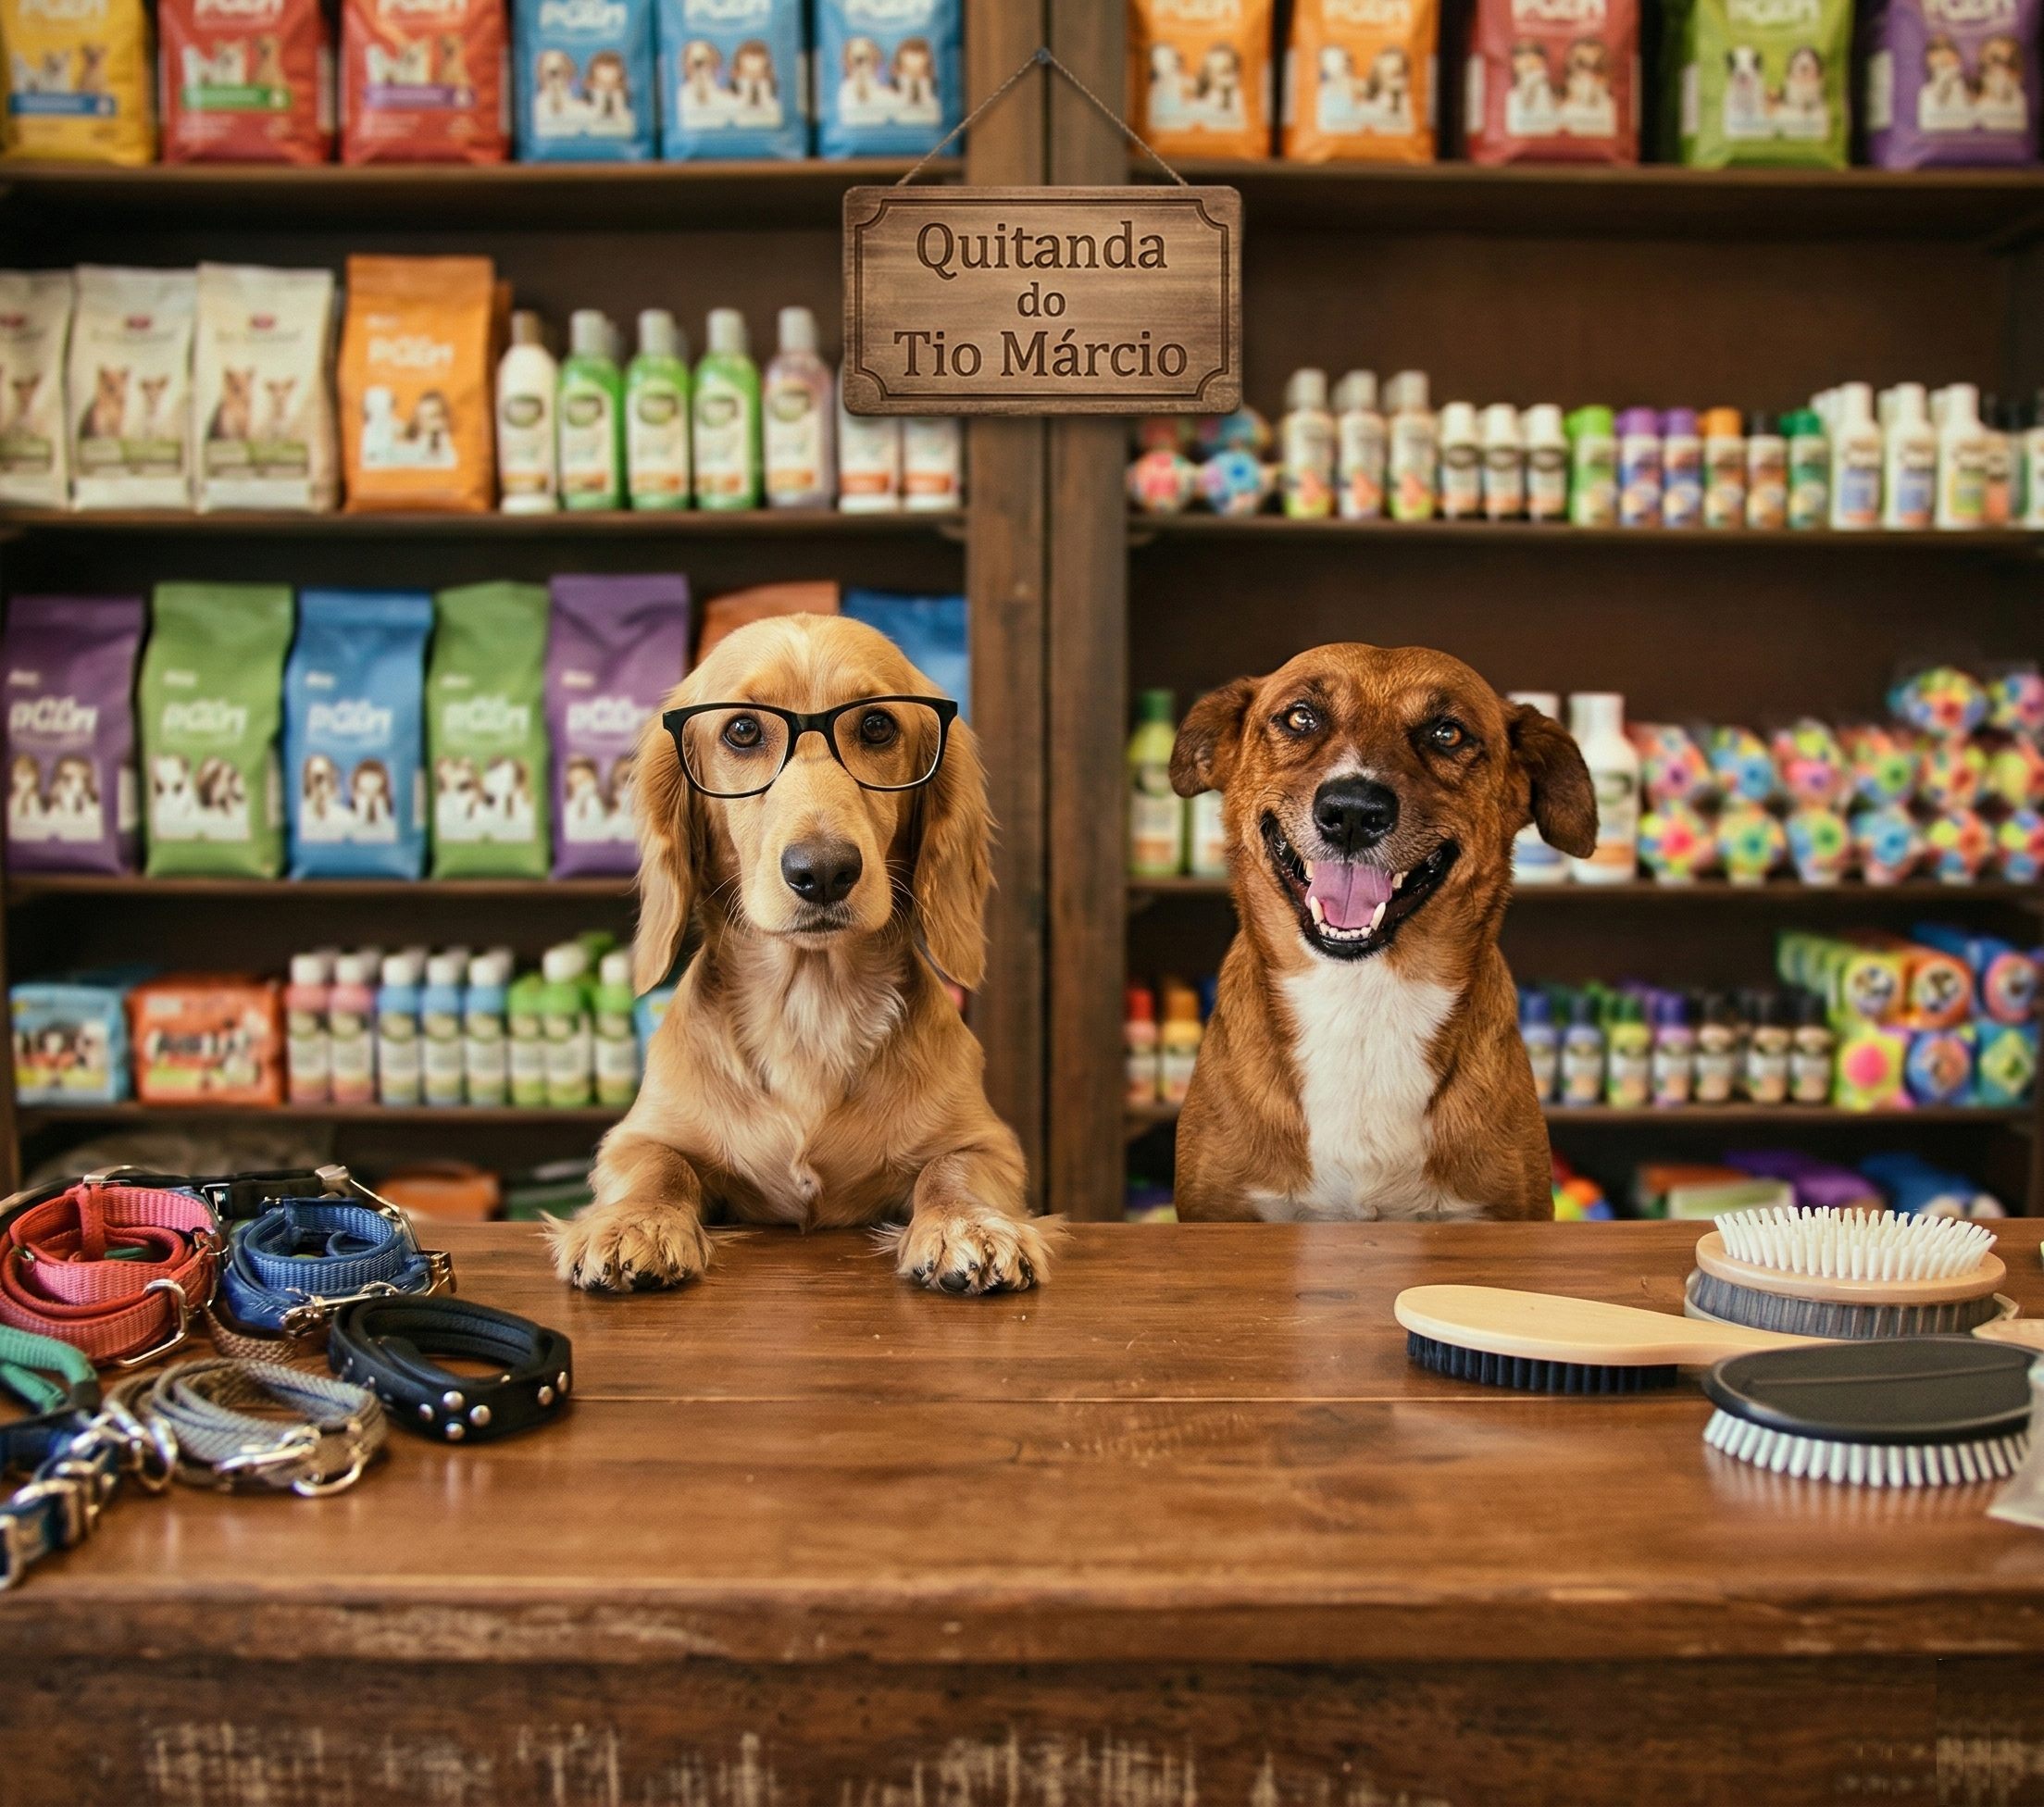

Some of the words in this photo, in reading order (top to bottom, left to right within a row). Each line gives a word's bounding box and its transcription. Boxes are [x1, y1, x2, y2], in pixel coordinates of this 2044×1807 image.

[916, 220, 1167, 280] Quitanda
[1016, 281, 1066, 318] do
[893, 330, 983, 377] Tio
[1000, 329, 1189, 377] Márcio
